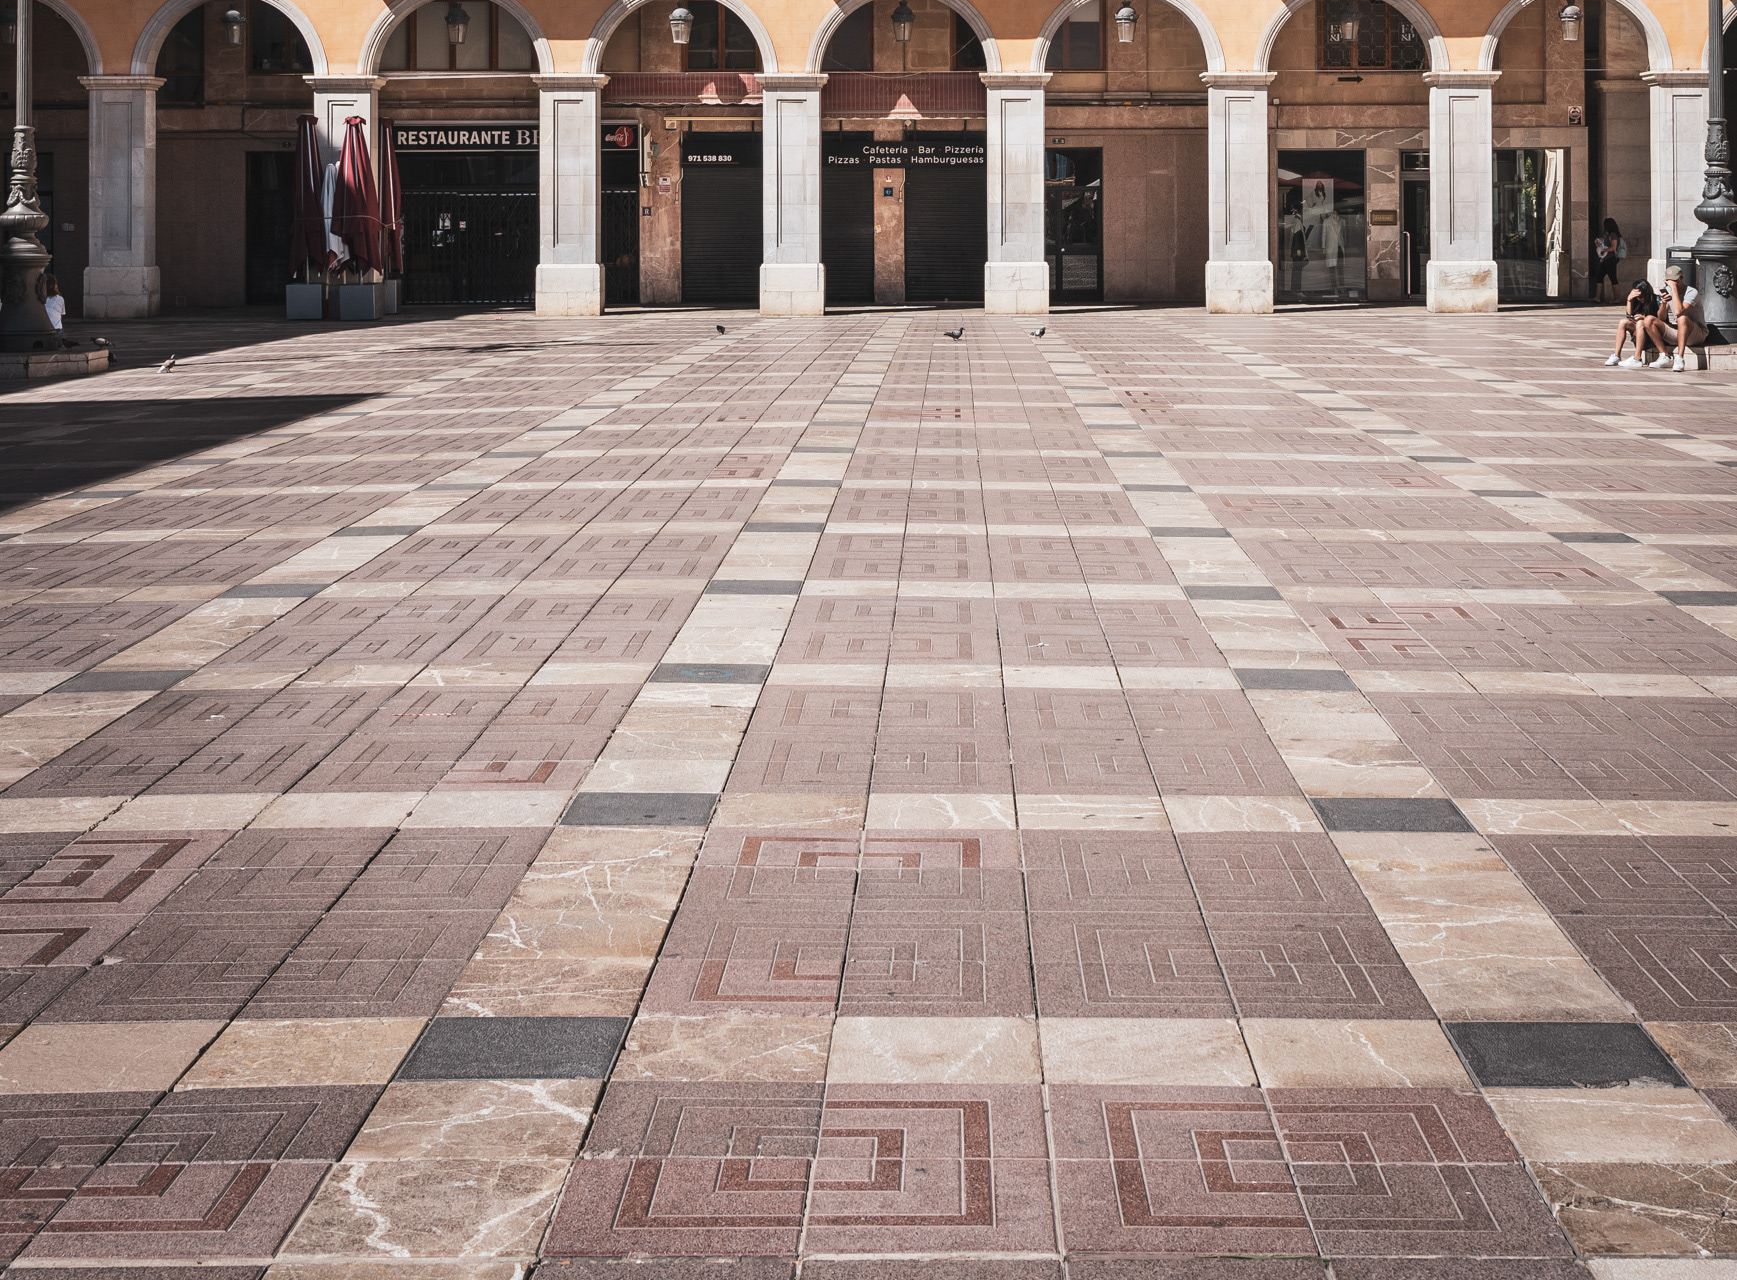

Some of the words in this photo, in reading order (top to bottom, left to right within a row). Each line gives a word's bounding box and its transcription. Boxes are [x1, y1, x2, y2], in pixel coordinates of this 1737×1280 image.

[397, 131, 510, 145] RESTAURANTE
[862, 146, 908, 154] Cafetería
[918, 146, 935, 154] Bar
[944, 146, 984, 154] Pizzería
[828, 156, 860, 164] Pizzas
[869, 156, 902, 164] Pastas
[911, 156, 984, 165] Hamburguesas
